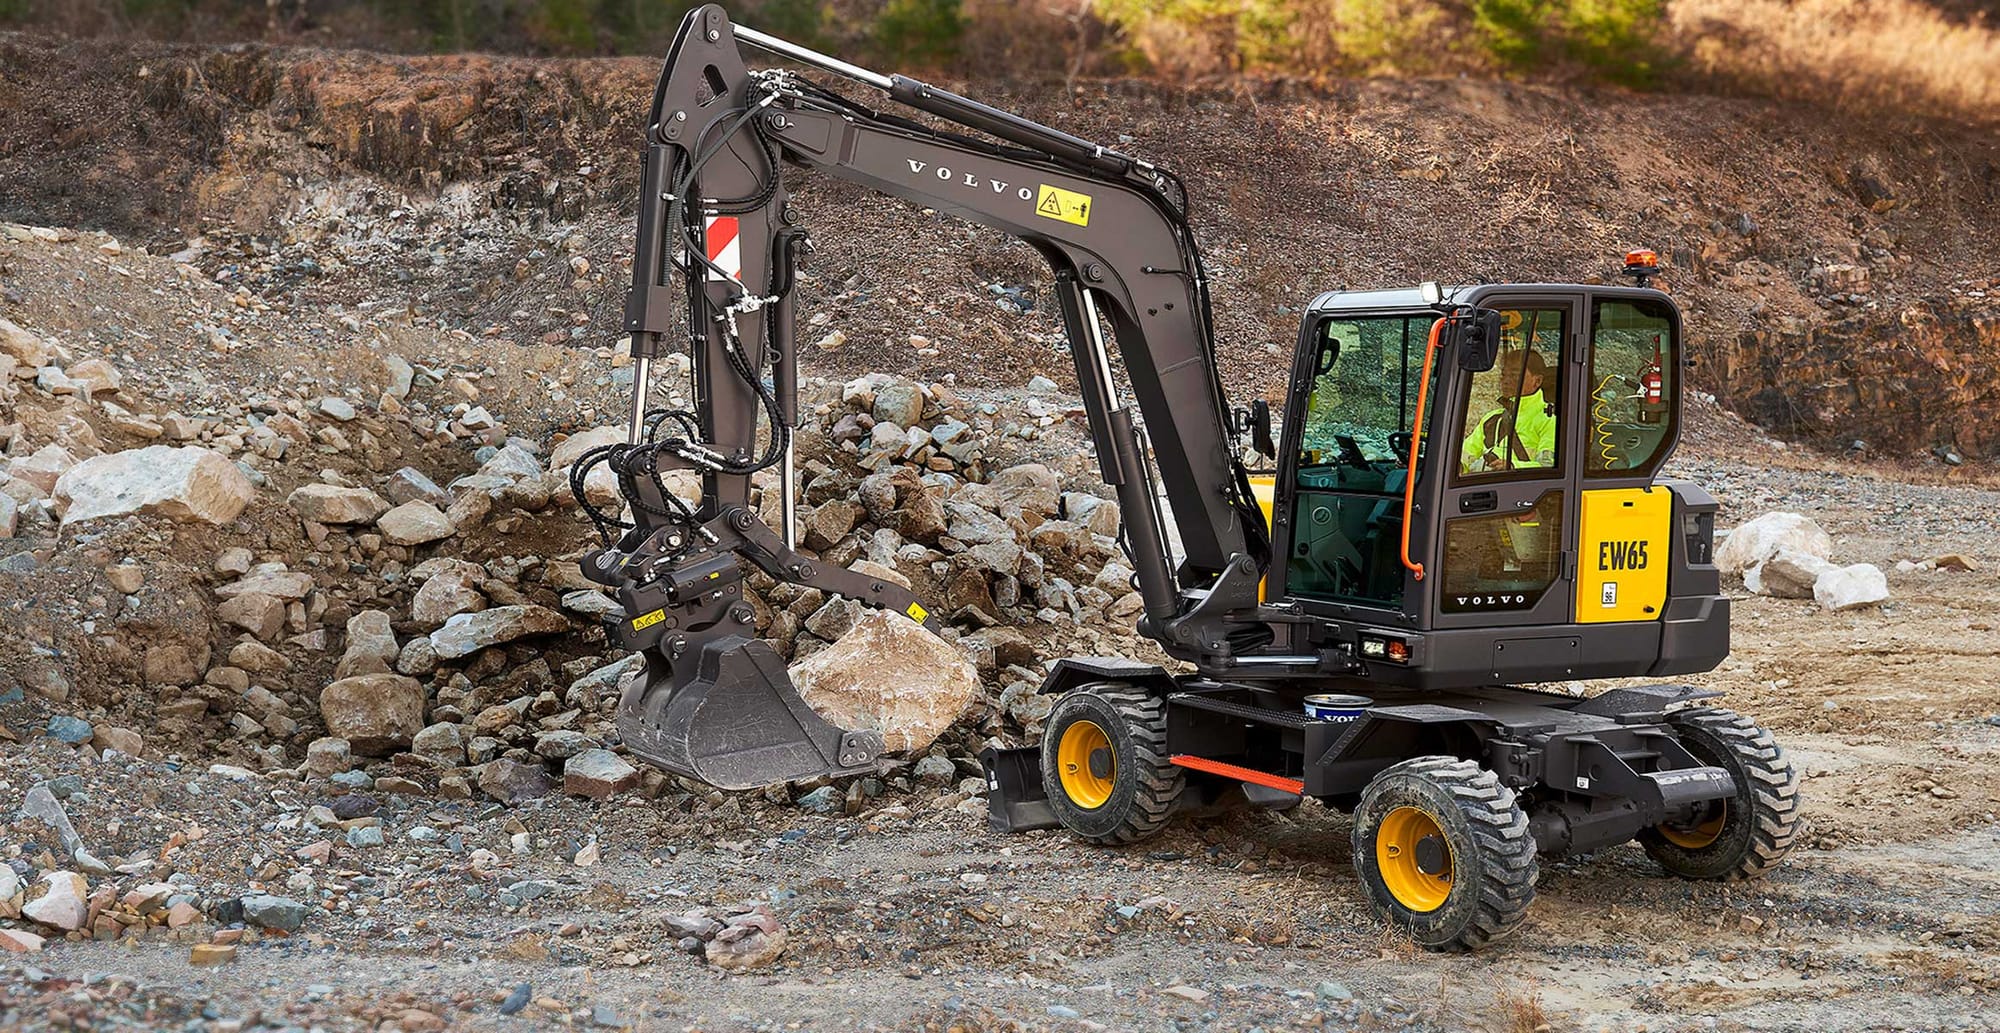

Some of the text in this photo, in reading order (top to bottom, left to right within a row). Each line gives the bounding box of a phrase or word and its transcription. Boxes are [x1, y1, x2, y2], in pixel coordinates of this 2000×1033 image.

[907, 159, 1032, 200] VOLVO
[1599, 541, 1648, 570] EW65
[1456, 595, 1525, 606] VOLVO
